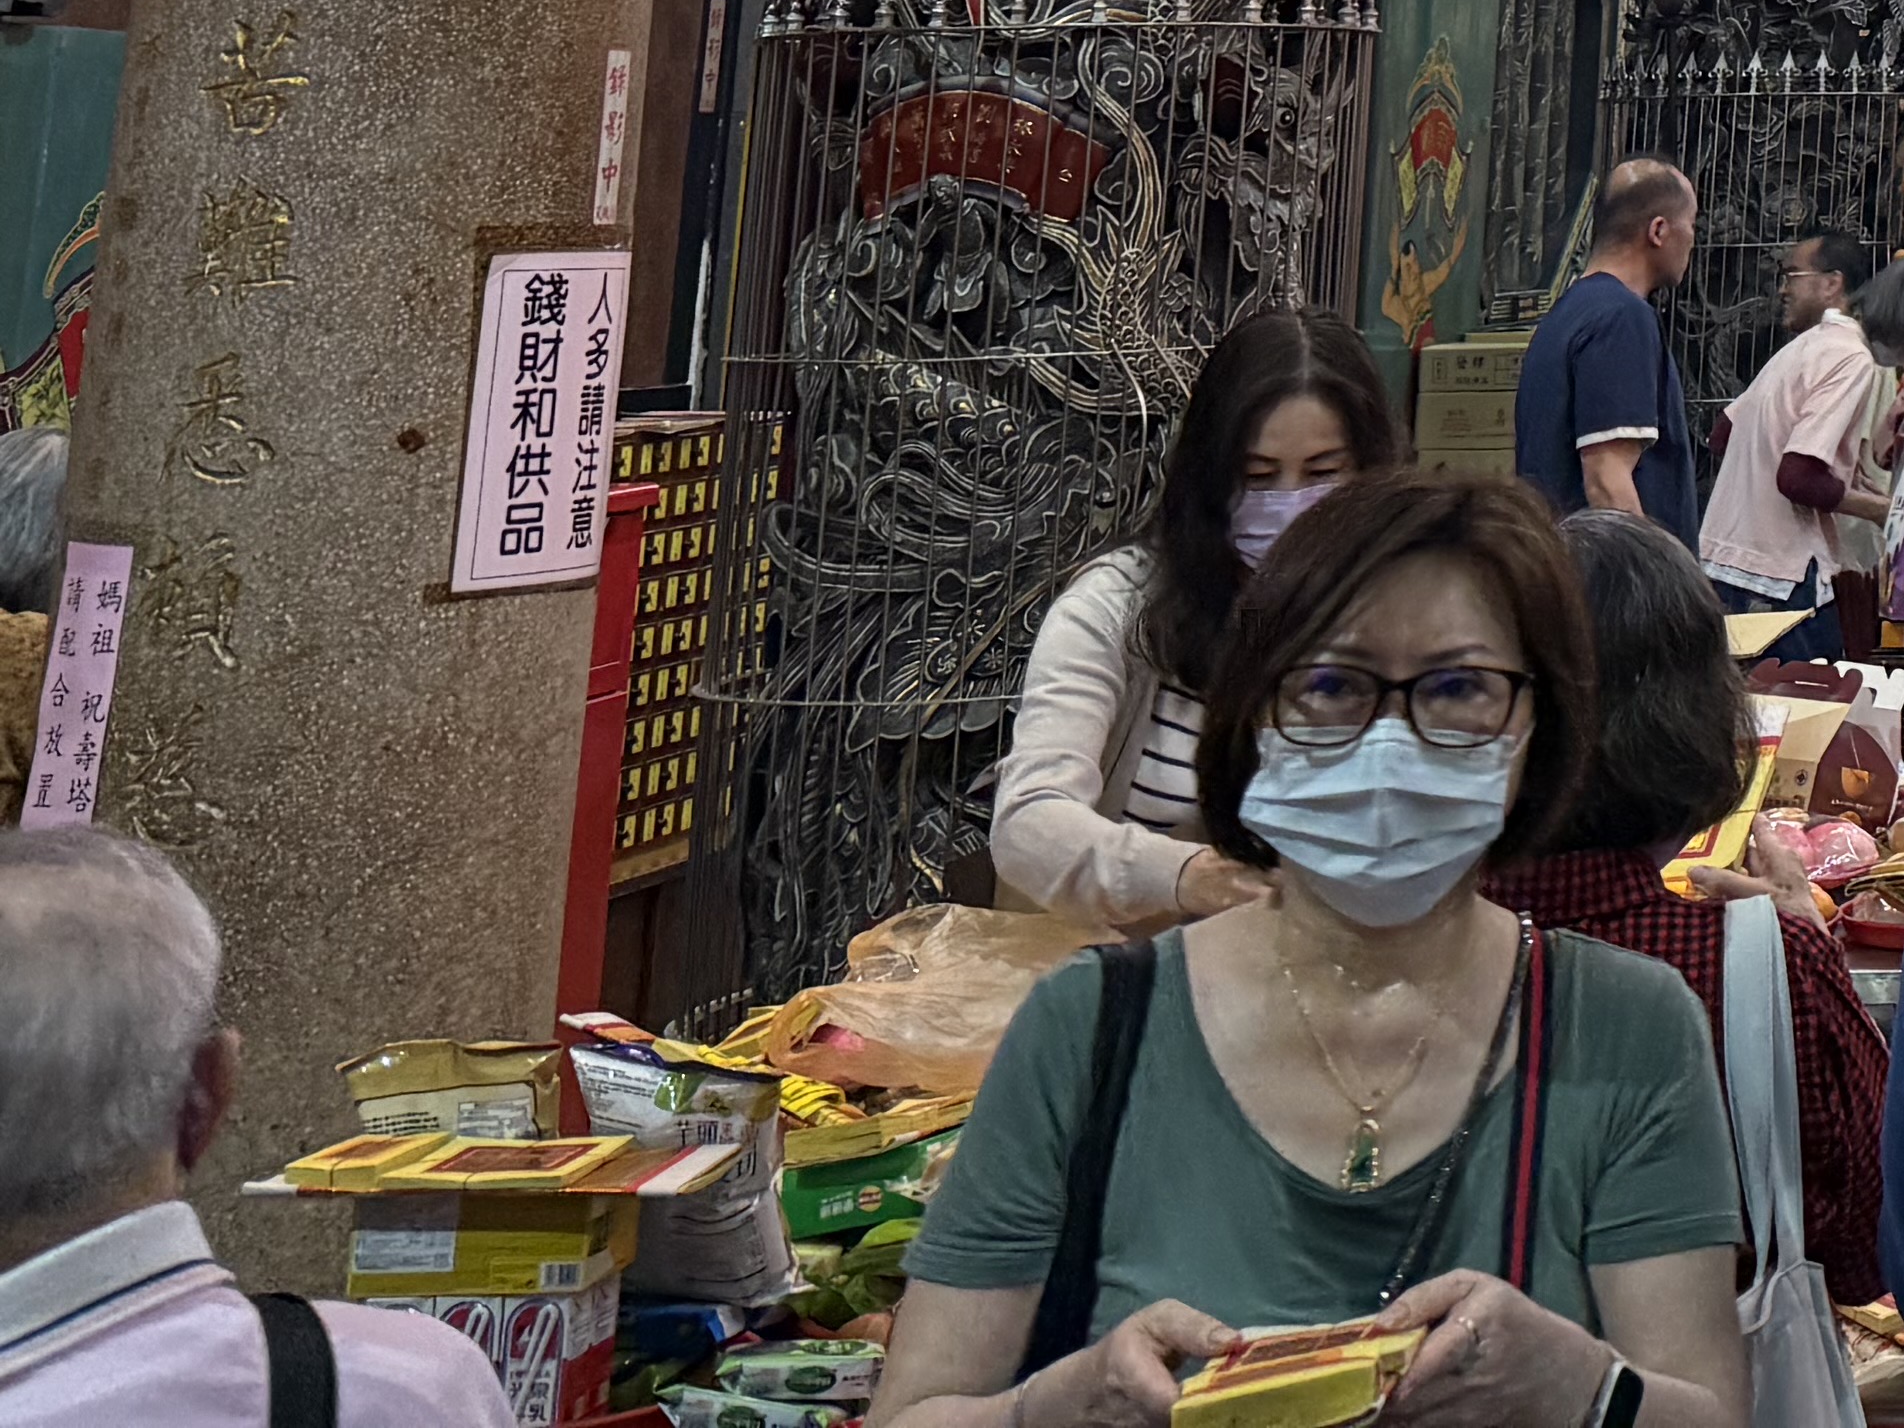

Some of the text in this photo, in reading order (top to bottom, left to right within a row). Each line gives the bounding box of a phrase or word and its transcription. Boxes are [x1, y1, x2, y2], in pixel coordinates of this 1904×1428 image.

[499, 272, 570, 556] 錢財和供品
[566, 271, 613, 551] 人多請注意
[33, 577, 85, 809] 請配合放置
